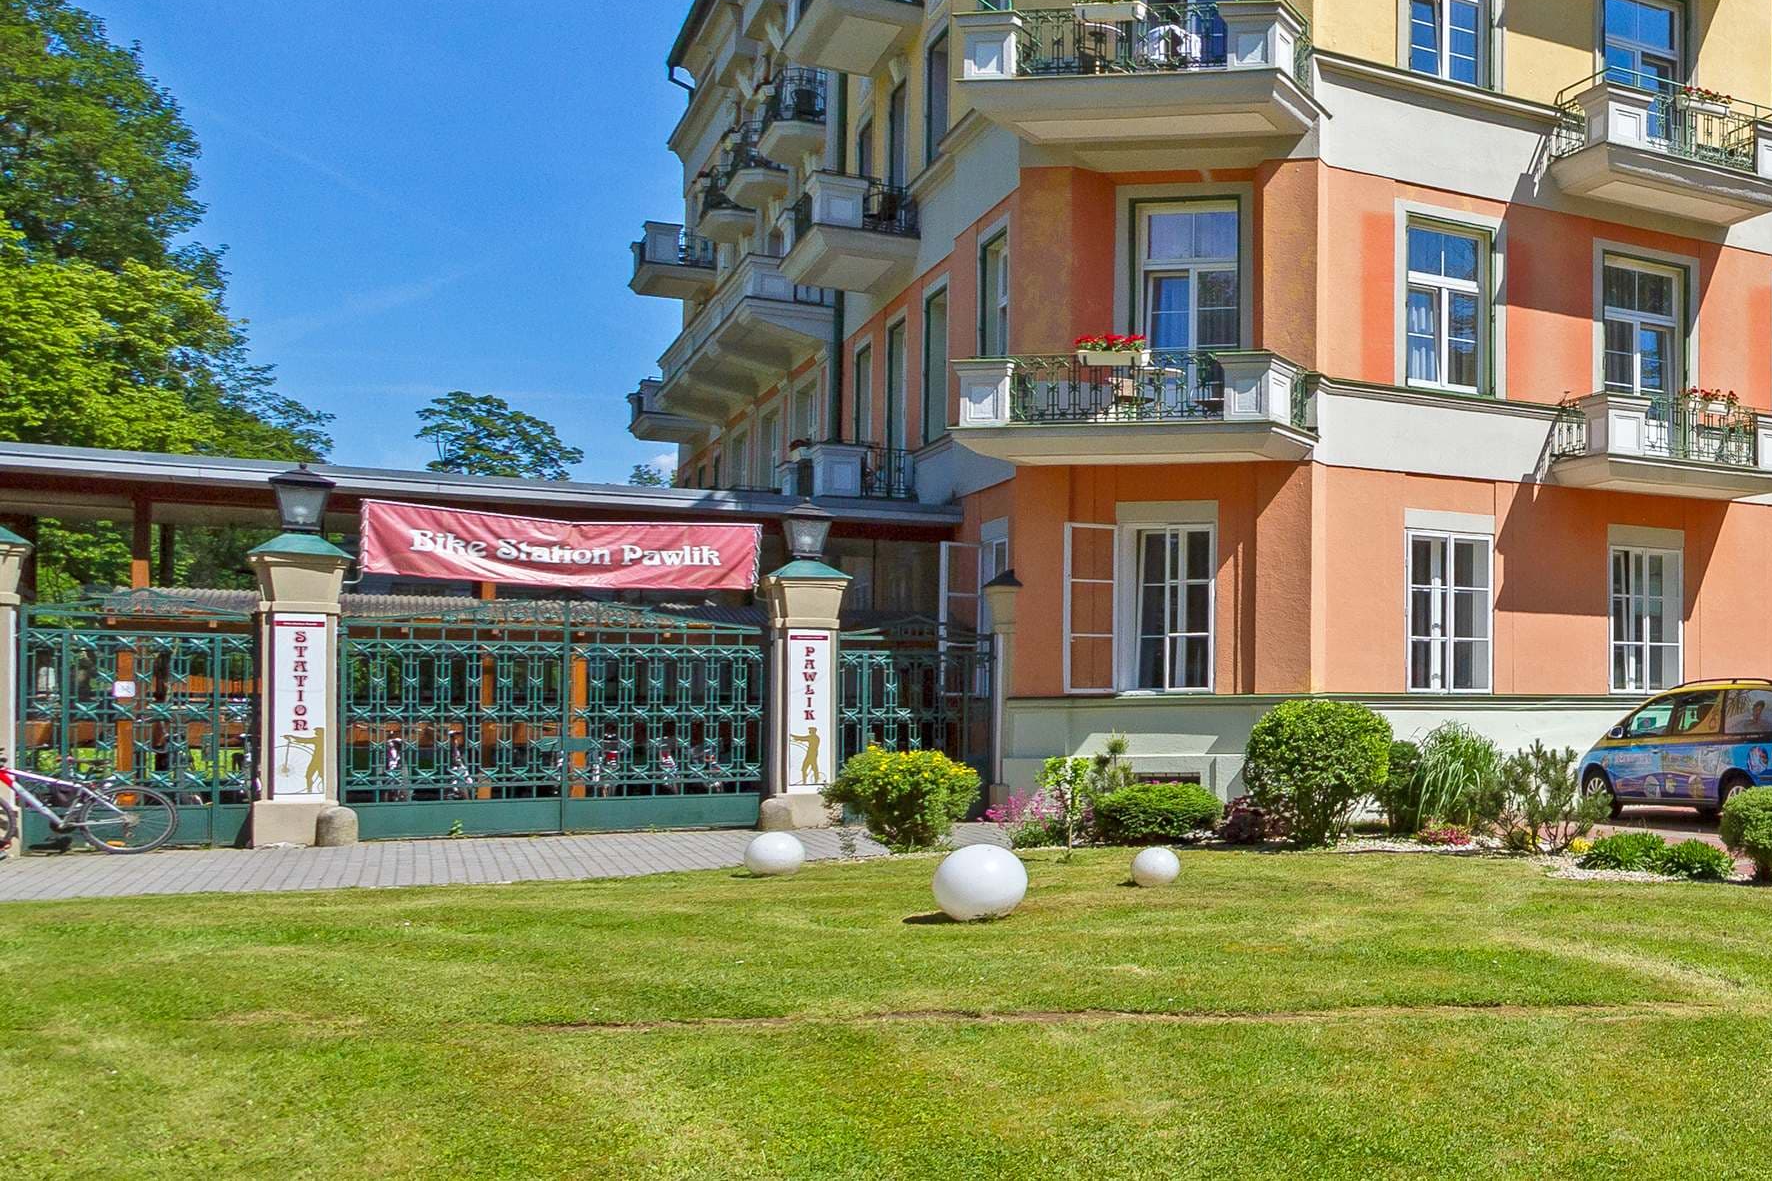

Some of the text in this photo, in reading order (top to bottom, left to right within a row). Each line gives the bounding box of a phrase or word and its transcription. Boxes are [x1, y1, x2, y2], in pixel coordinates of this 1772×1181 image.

[410, 529, 721, 566] Bike Station Pawlik
[292, 631, 309, 731] STATION
[802, 646, 817, 721] PAWLIK
